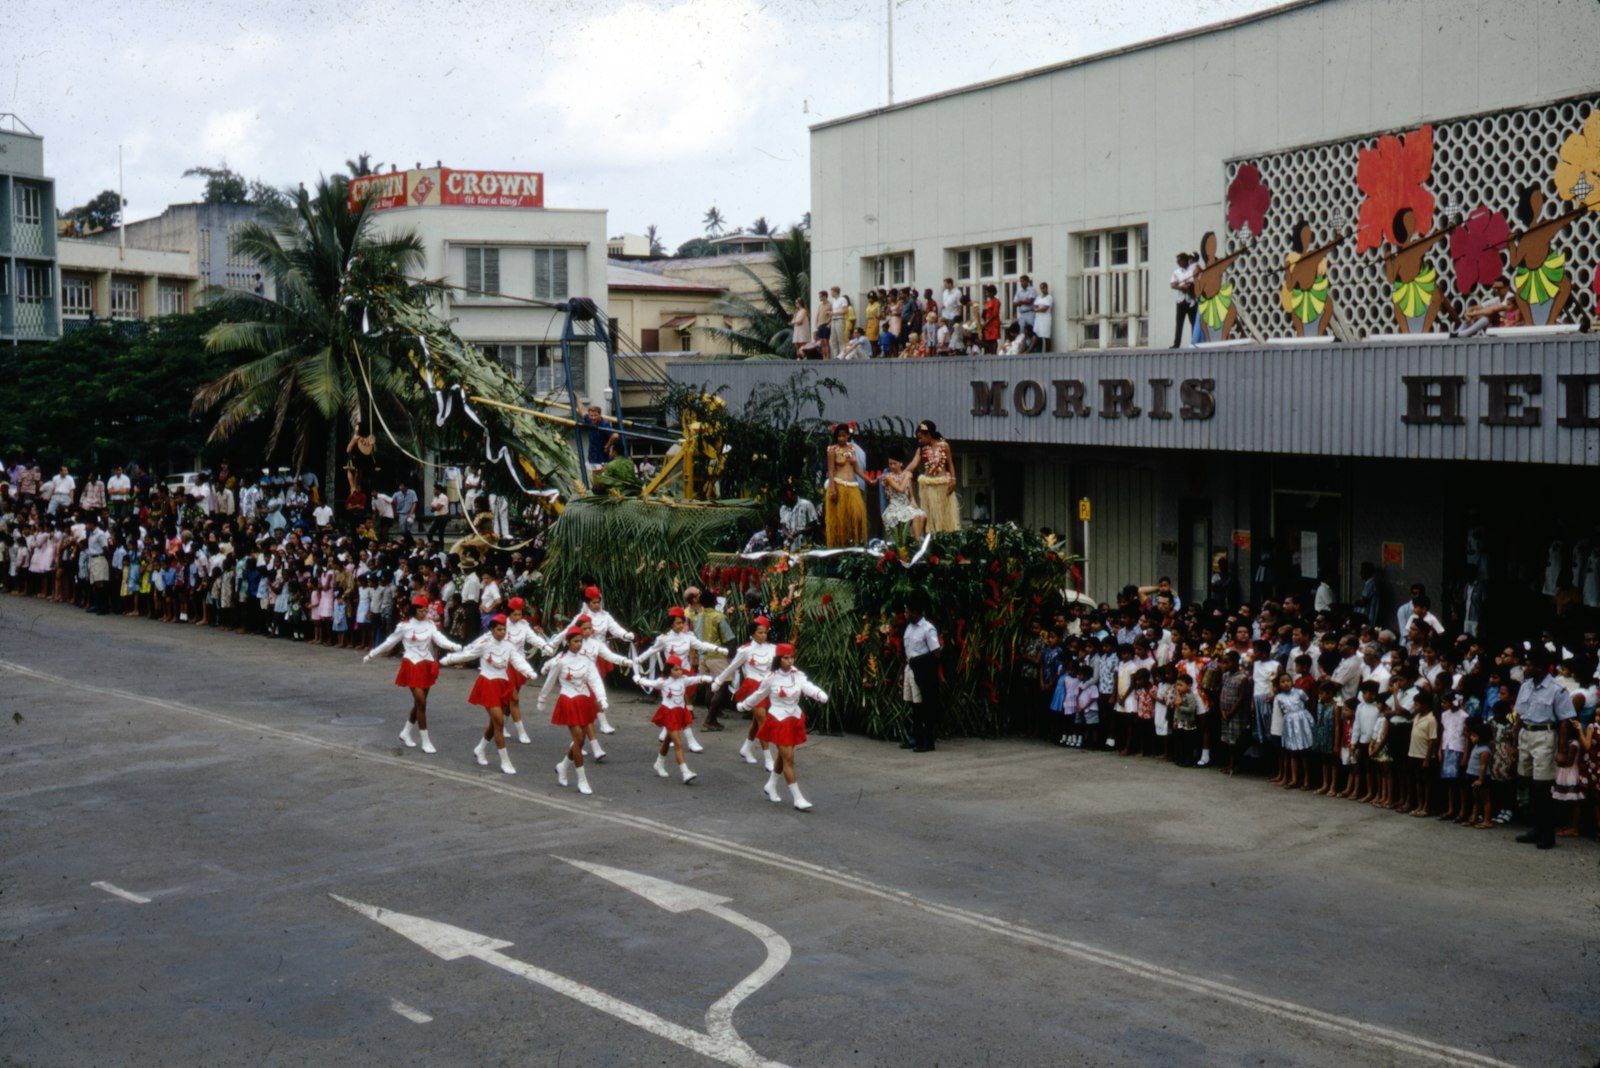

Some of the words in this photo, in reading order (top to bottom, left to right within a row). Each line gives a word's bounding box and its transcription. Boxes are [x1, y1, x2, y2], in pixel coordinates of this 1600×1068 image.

[446, 172, 538, 196] CROWN
[464, 196, 475, 204] fit
[477, 196, 490, 204] for
[970, 378, 1216, 420] MORRIS
